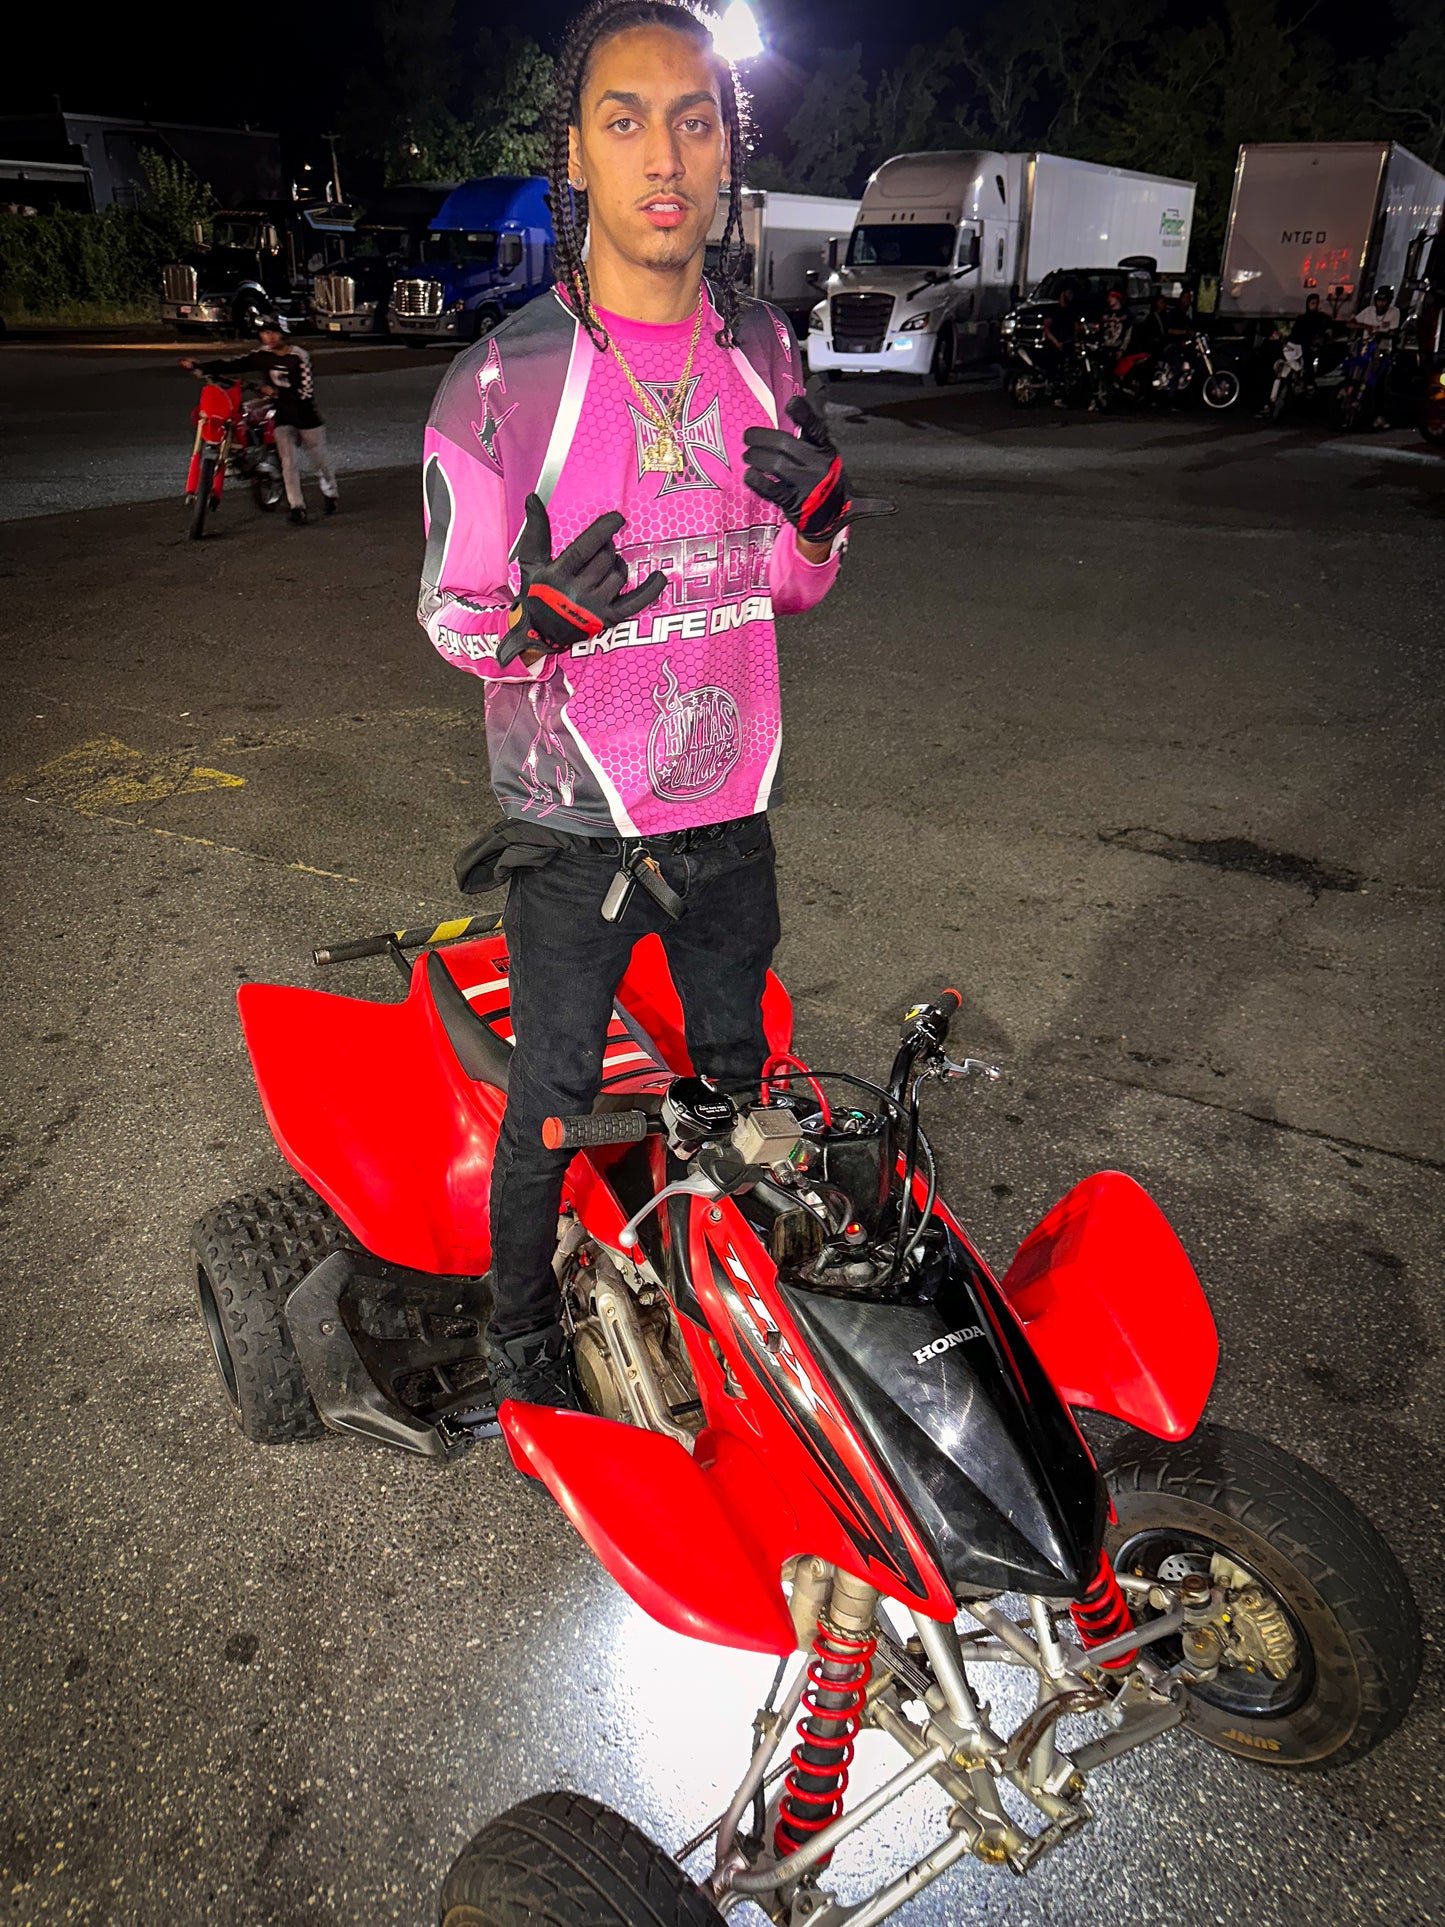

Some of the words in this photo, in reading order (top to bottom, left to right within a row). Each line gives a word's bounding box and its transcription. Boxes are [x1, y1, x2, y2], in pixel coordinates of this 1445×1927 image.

[663, 699, 735, 757] HITTAS
[724, 1241, 836, 1421] TRX
[912, 1325, 986, 1365] HONDA
